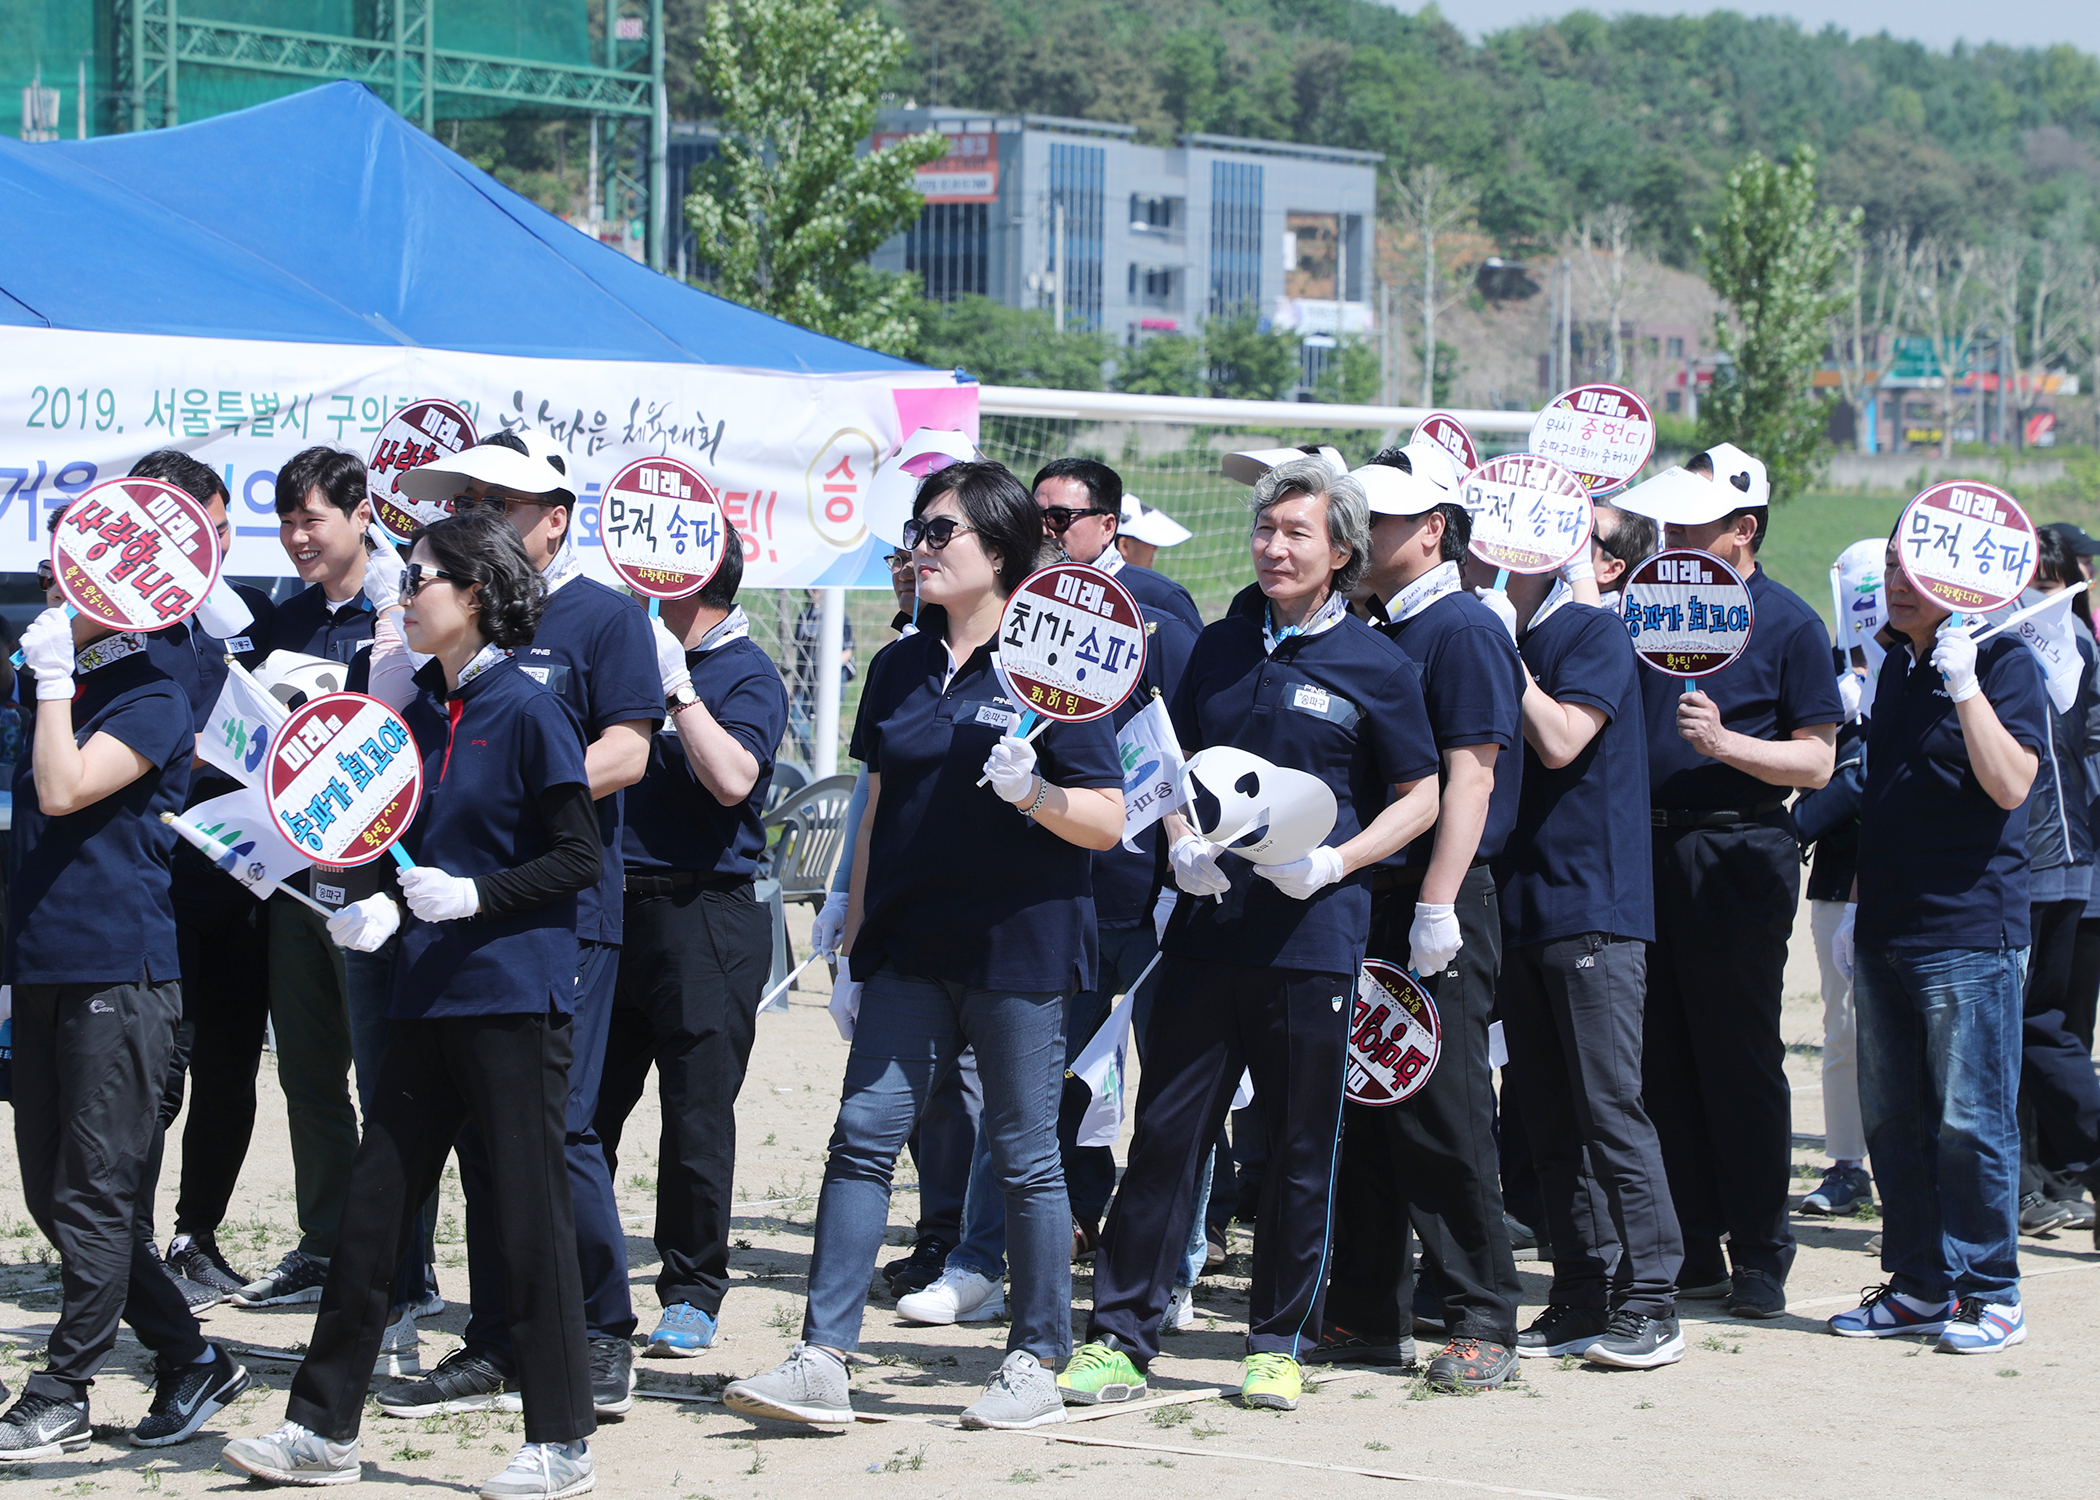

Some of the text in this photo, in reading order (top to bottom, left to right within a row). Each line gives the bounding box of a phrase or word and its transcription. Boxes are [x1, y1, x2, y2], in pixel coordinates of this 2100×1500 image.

[26, 385, 124, 435] 2019.
[144, 388, 314, 440] 서울특별시
[623, 397, 725, 466] 체육대회
[824, 455, 858, 523] 승
[608, 496, 720, 561] 무적 송파
[1528, 495, 1586, 546] 송파
[67, 499, 195, 622] 사랑합니다
[1488, 547, 1539, 564] 사랑합니다
[1907, 510, 2031, 586] 무적 송파
[73, 576, 83, 588] 수
[85, 585, 115, 618] 있습니다
[638, 567, 685, 584] 사랑합니다
[1054, 573, 1115, 617] 미래팀
[1932, 582, 1984, 605] 사랑합니다
[1624, 595, 1750, 638] 송파가 최고야
[1075, 626, 1139, 682] 송파
[983, 710, 1008, 724] 송파구
[1301, 694, 1326, 708] 송파구
[280, 776, 354, 851] 송파가
[336, 717, 409, 792] 최고야
[319, 887, 342, 901] 송파구
